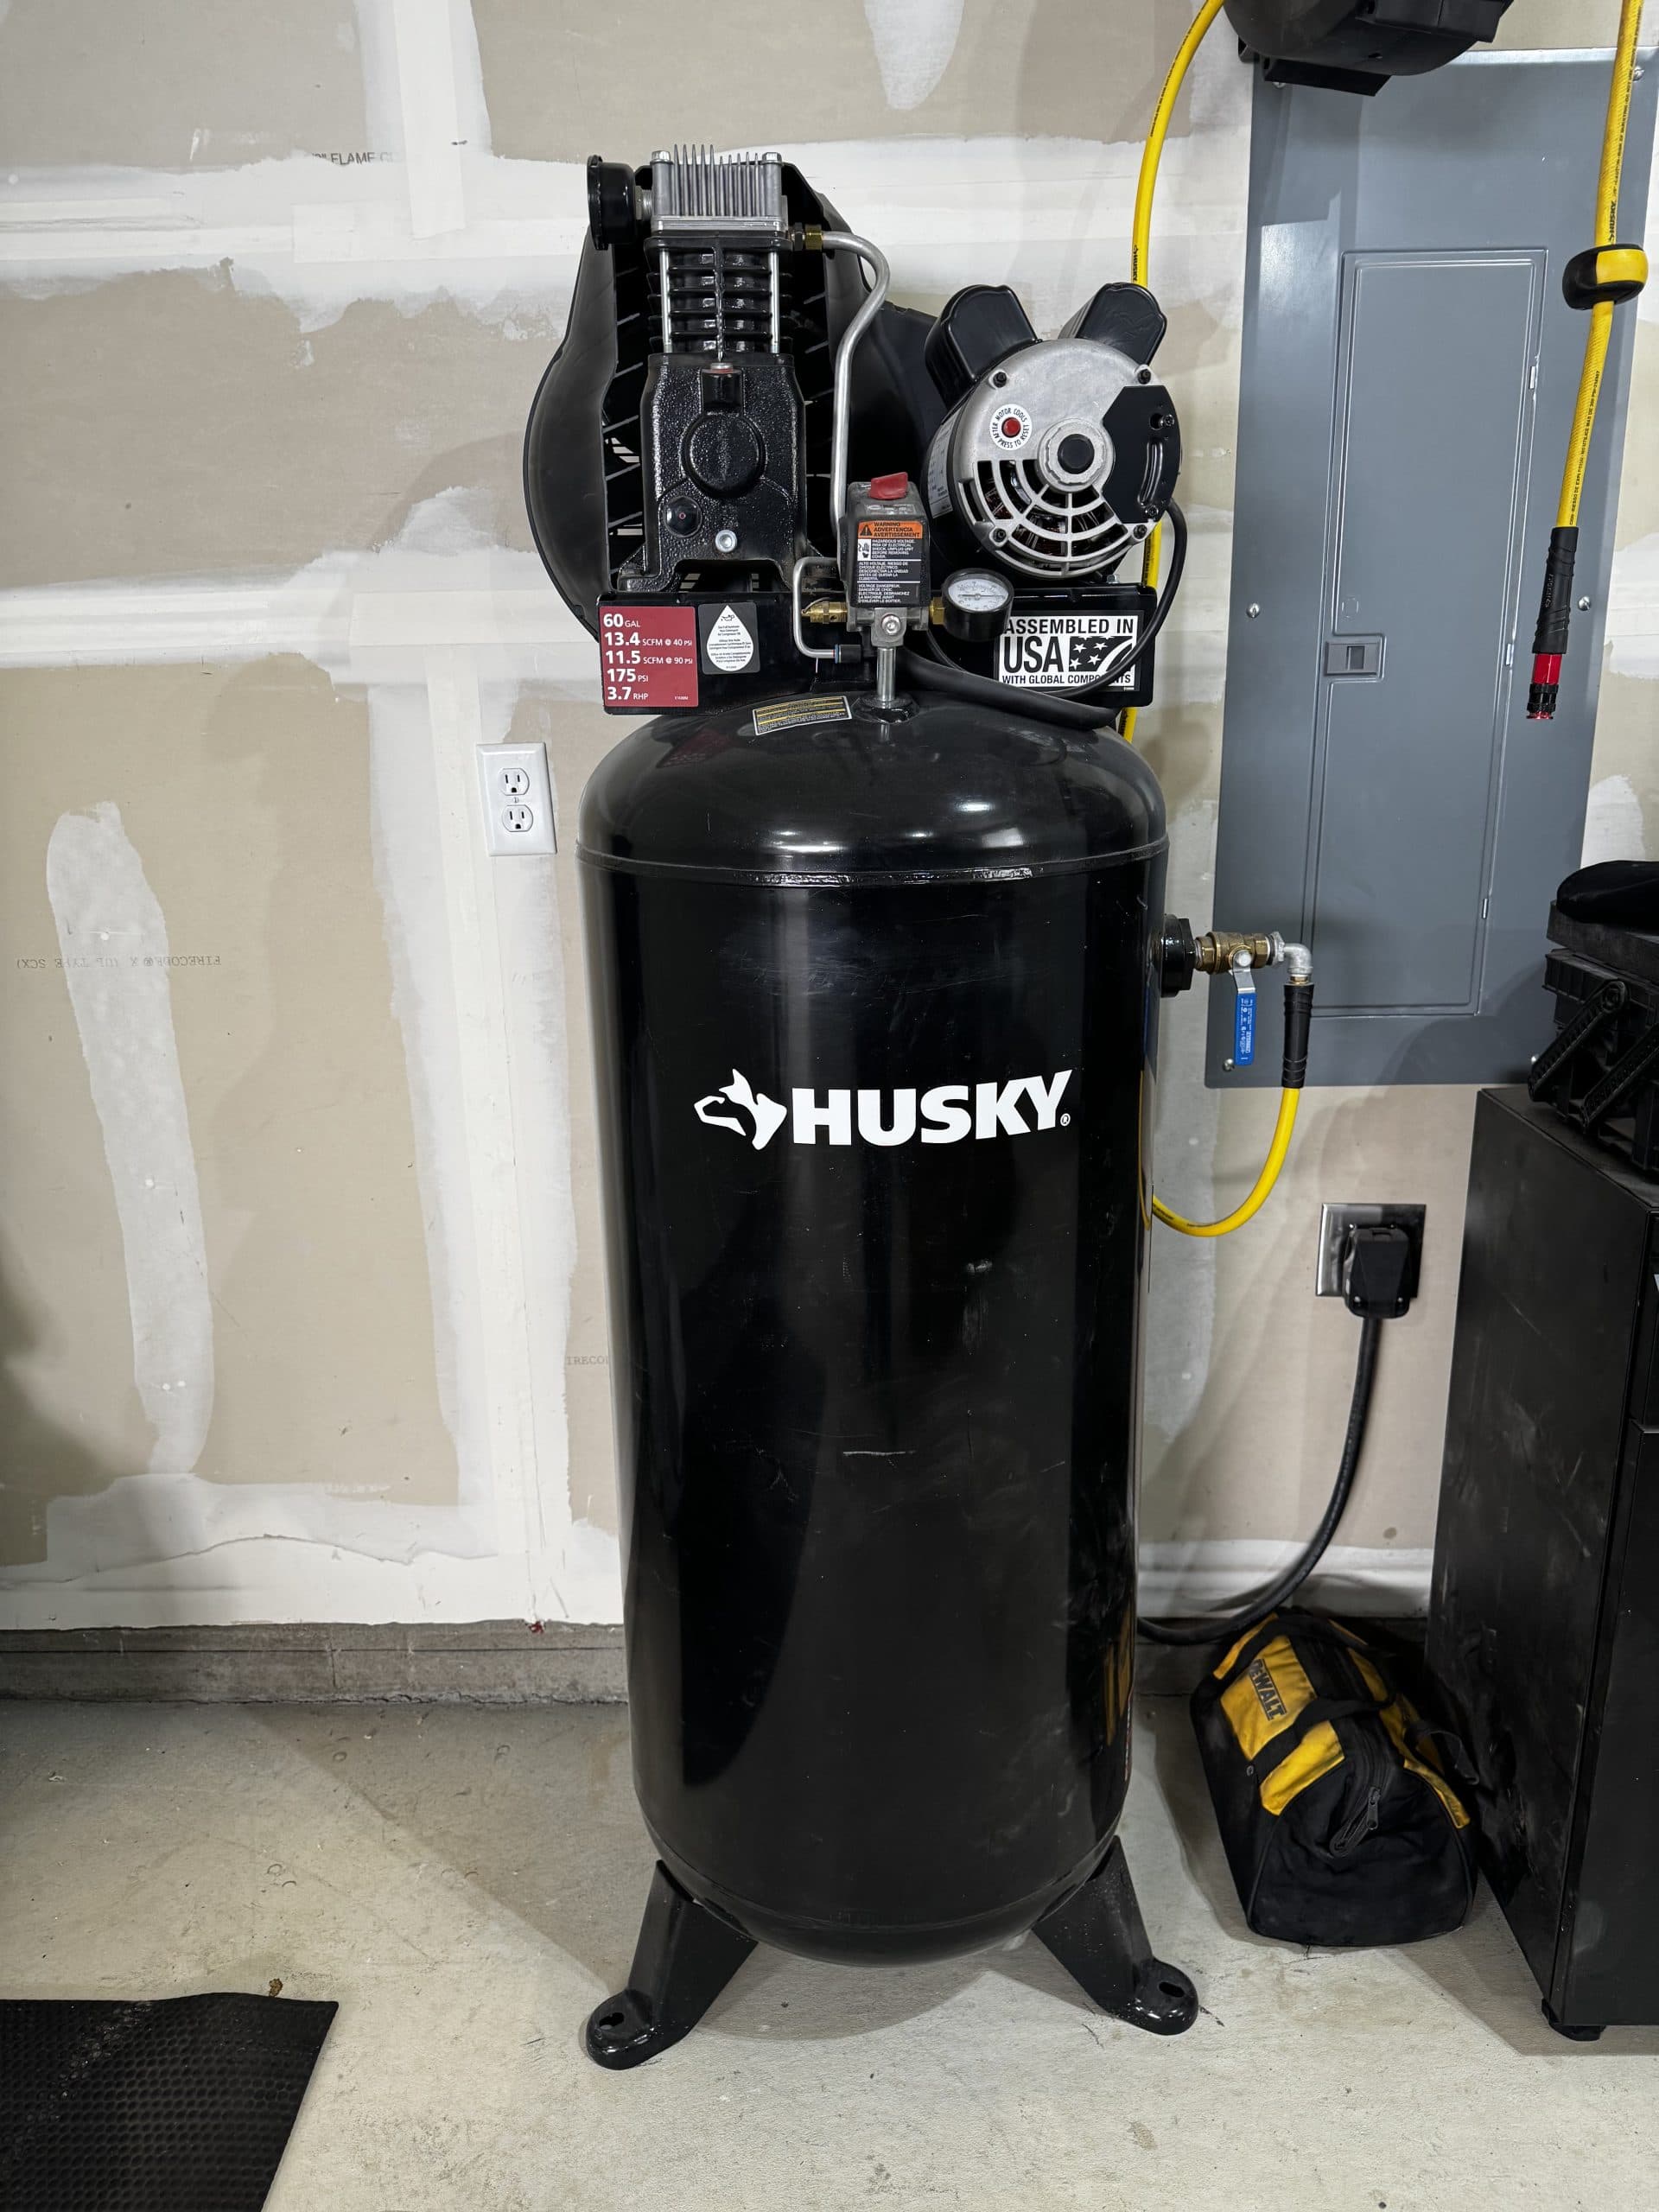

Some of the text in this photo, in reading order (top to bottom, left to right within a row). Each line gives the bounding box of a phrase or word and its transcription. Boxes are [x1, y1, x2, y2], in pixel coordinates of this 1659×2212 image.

[995, 408, 1011, 421] MOTOR
[1013, 408, 1027, 422] COOLS
[998, 438, 1013, 448] PRESS
[1020, 425, 1030, 441] RESET
[603, 614, 623, 627] 60
[1005, 619, 1133, 634] ASSEMBLED IN
[605, 632, 640, 646] 13.4
[606, 650, 641, 664] 11.5
[1004, 636, 1064, 673] USA
[607, 669, 636, 682] 175
[1002, 675, 1026, 684] WITH
[1029, 675, 1064, 684] GLOBAL
[608, 687, 632, 700] 3.7
[17, 959, 46, 969] SCX)
